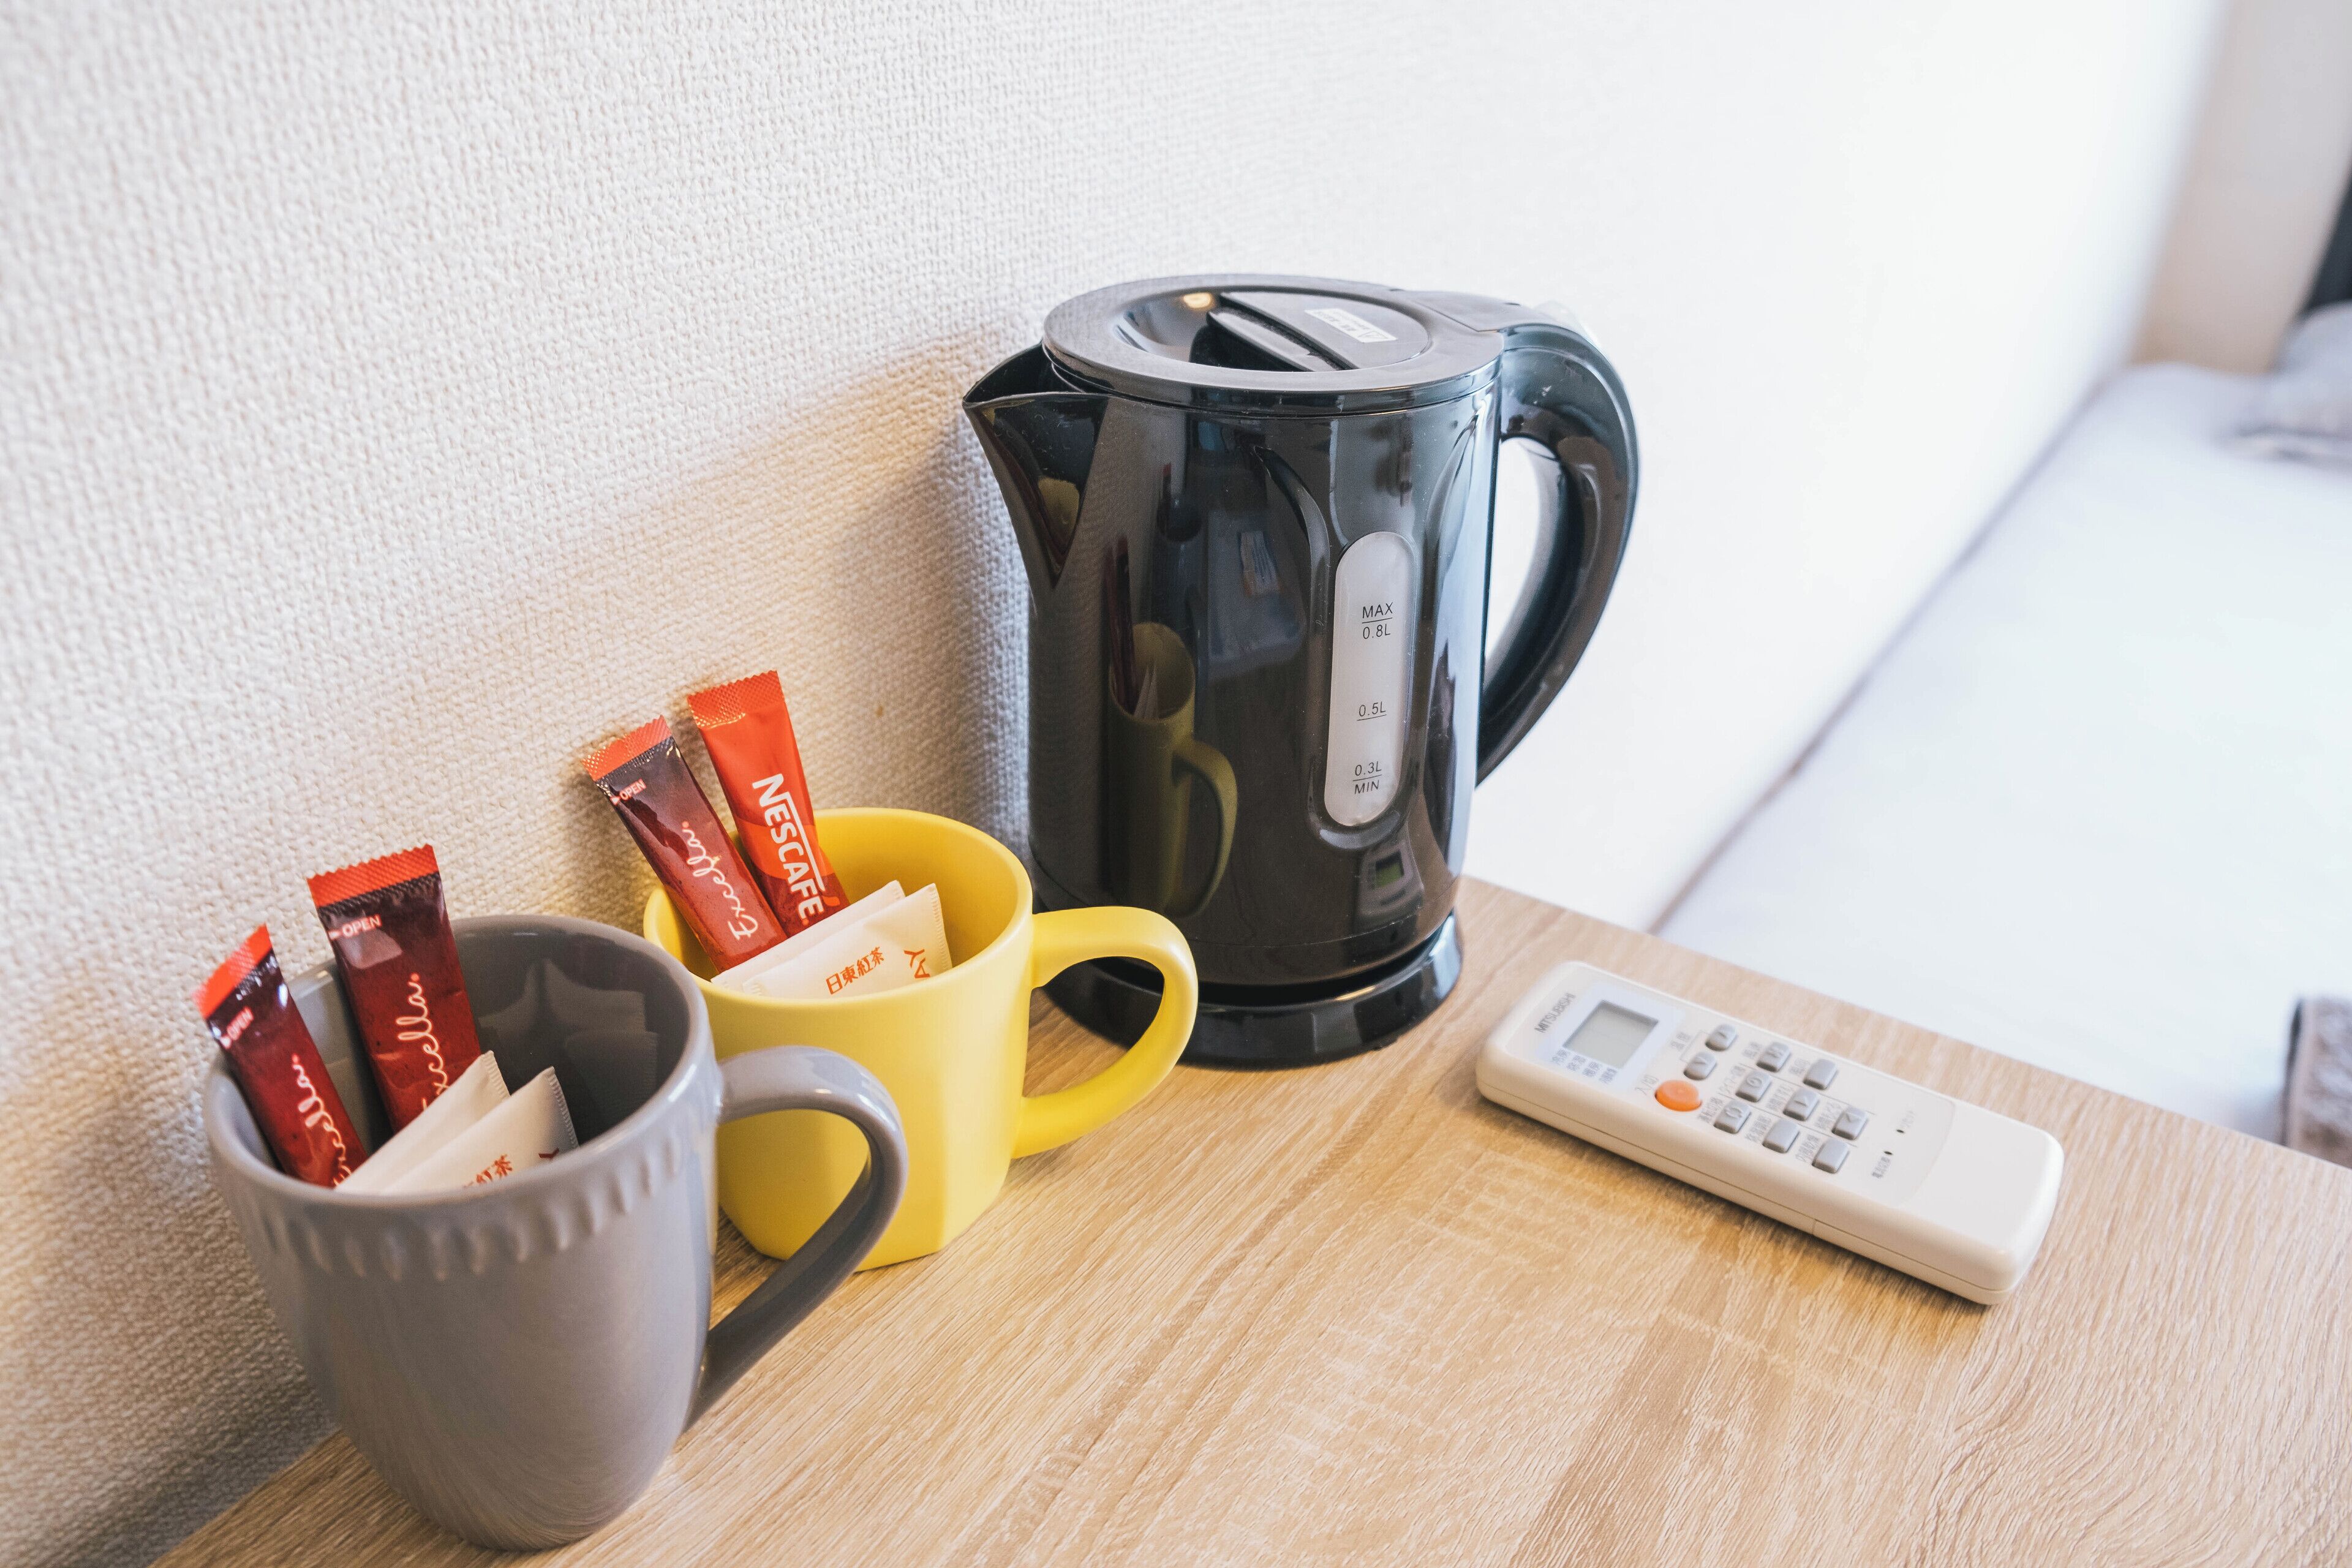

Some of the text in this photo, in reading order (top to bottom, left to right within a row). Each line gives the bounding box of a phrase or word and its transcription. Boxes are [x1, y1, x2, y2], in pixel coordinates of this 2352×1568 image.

[1362, 602, 1393, 619] MAX
[1363, 624, 1390, 639] 0.8L
[1359, 701, 1386, 717] 0.5L
[1355, 761, 1382, 776] 0.3L
[620, 779, 646, 801] OPEN
[1354, 780, 1379, 794] MIN
[342, 914, 382, 937] OPEN
[826, 946, 884, 995] 日東紅茶
[227, 1006, 254, 1040] OPEN
[1532, 992, 1577, 1033] MITSUBISHI
[396, 980, 452, 1113] xcella
